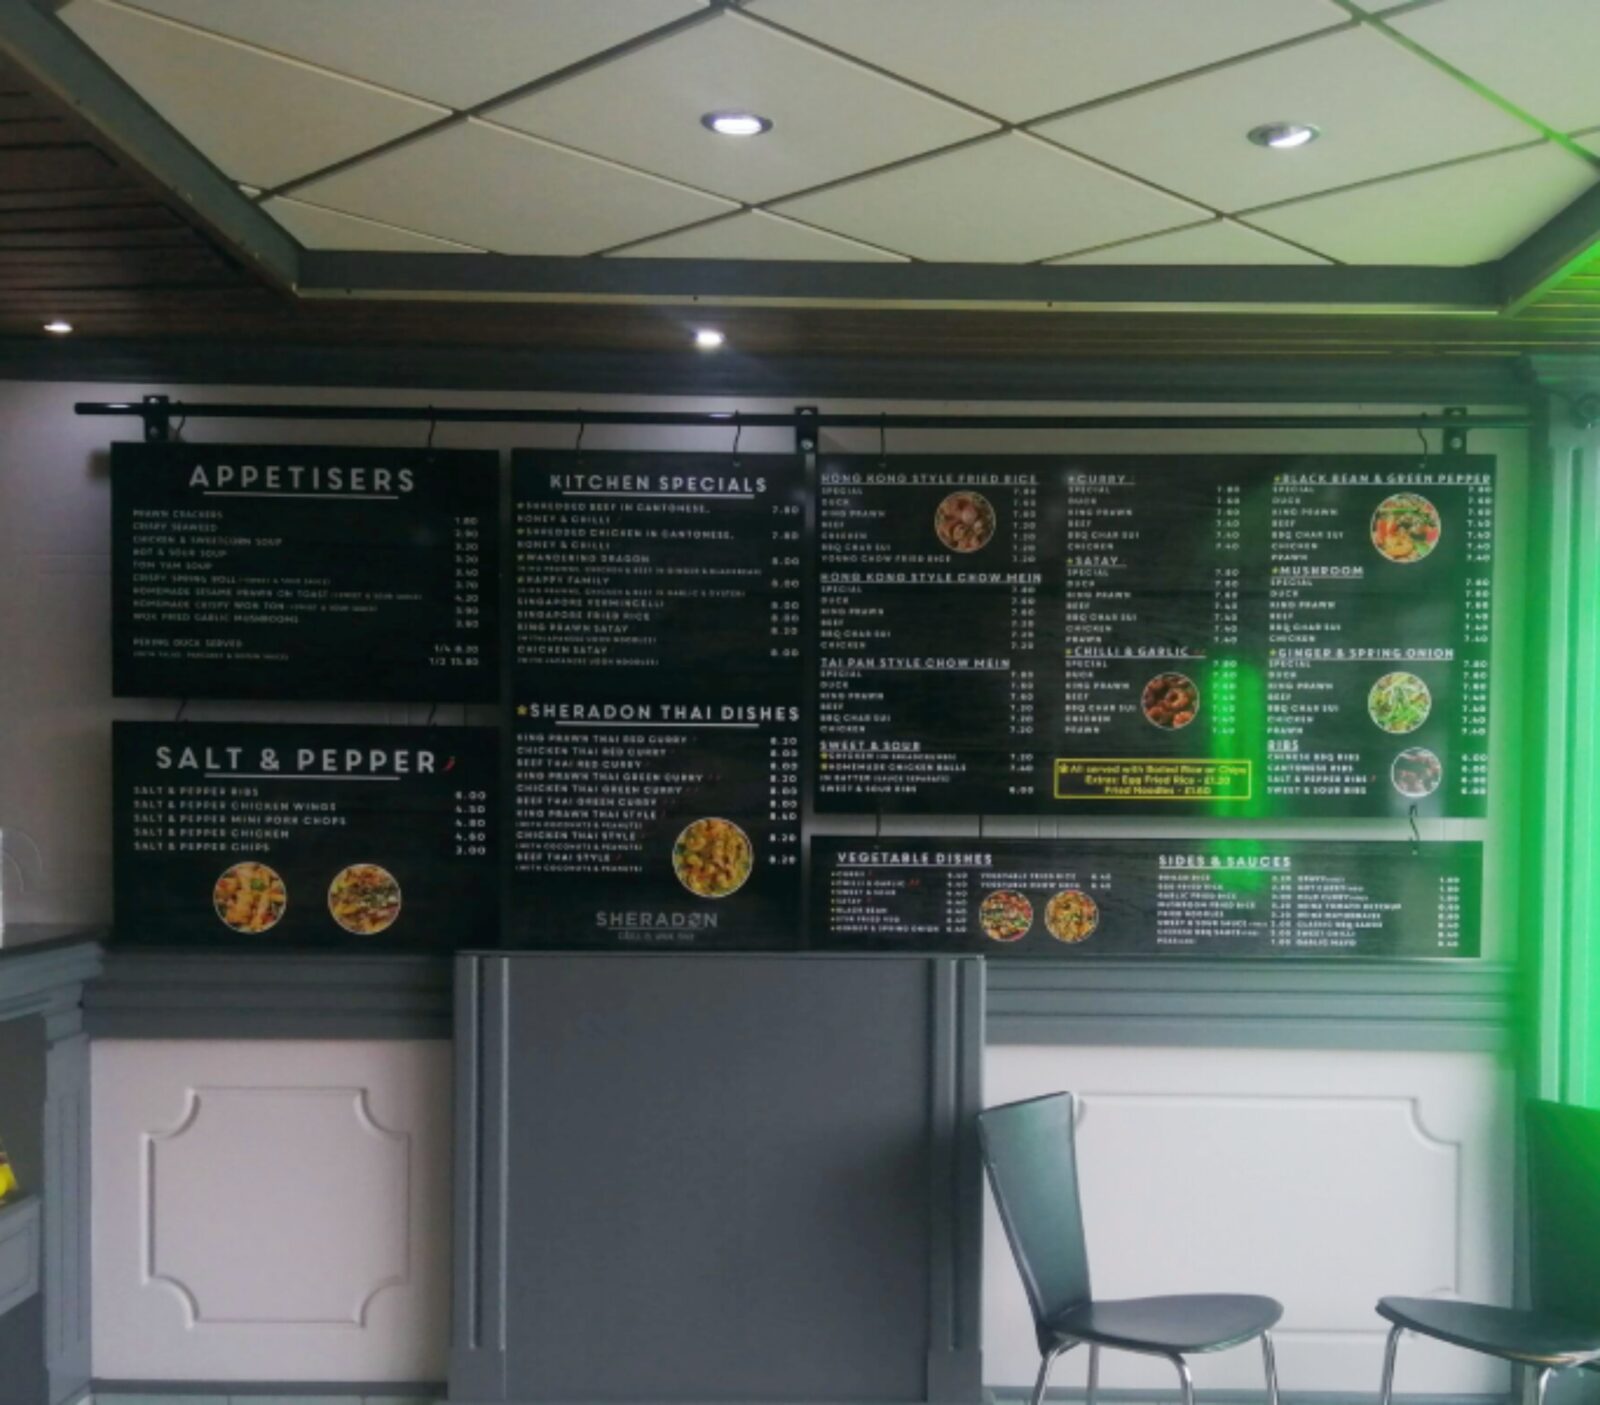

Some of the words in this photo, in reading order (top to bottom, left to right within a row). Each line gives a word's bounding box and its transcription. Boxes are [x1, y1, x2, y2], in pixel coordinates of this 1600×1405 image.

[189, 466, 414, 492] APPETISERS
[821, 474, 862, 483] HONG
[867, 474, 907, 483] KONG
[912, 474, 952, 483] STYLE
[958, 474, 999, 483] FRIED
[1004, 474, 1036, 483] RICE
[1077, 475, 1125, 483] CURRY
[1283, 474, 1326, 483] BLACK
[1332, 475, 1368, 483] BEAN
[1374, 475, 1381, 483] &
[1387, 475, 1432, 483] GREEN
[1438, 475, 1490, 483] PEPPER
[550, 475, 649, 492] KITCHEN
[659, 476, 767, 493] SPECIALS
[526, 503, 586, 511] SHREDDED
[590, 503, 616, 512] BEEF
[620, 504, 632, 512] IN
[526, 529, 586, 538] SHREDDED
[590, 529, 642, 538] CHICKEN
[646, 530, 657, 539] IN
[1075, 557, 1118, 565] SATAY
[1280, 567, 1363, 575] MUSHROOM
[820, 574, 861, 582] HONG
[866, 574, 905, 582] KONG
[911, 574, 951, 582] STYLE
[957, 574, 1001, 582] CHOW
[1007, 574, 1041, 582] MEIN
[1075, 647, 1119, 656] CHILLI
[1124, 648, 1131, 656] &
[1138, 648, 1188, 657] GARLIC
[1279, 649, 1330, 657] GINGER
[1336, 649, 1344, 657] &
[1349, 649, 1401, 657] SPRING
[1406, 649, 1453, 658] ONION
[821, 658, 842, 667] TAI
[848, 658, 874, 667] PAN
[880, 658, 920, 668] STYLE
[925, 659, 969, 668] CHOW
[974, 659, 1010, 668] MEIN
[530, 704, 650, 720] SHERADON
[660, 706, 711, 721] THAI
[721, 707, 799, 722] DISHES
[593, 735, 619, 743] THAI
[516, 746, 568, 755] CHICKEN
[573, 747, 597, 755] THAI
[821, 741, 864, 750] SWEET
[871, 742, 878, 750] &
[883, 742, 920, 750] SOUR
[157, 747, 242, 771] SALT
[259, 748, 280, 771] &
[298, 749, 435, 774] PEPPER
[593, 773, 619, 782] THAI
[133, 787, 163, 796] SALT
[168, 787, 176, 796] &
[180, 787, 226, 797] PEPPER
[231, 788, 259, 797] RIBS
[516, 784, 568, 793] CHICKEN
[572, 785, 597, 793] THAI
[602, 785, 639, 794] GREEN
[133, 800, 163, 809] SALT
[168, 801, 176, 810] &
[180, 801, 226, 810] PEPPER
[231, 802, 289, 811] CHICKEN
[293, 802, 336, 811] WINGS
[133, 815, 163, 824] SALT
[168, 815, 176, 824] &
[180, 815, 226, 824] PEPPER
[231, 816, 261, 825] MINI
[265, 816, 298, 825] PORK
[303, 817, 346, 826] CHOPS
[133, 828, 163, 837] SALT
[168, 829, 176, 837] &
[180, 829, 226, 838] PEPPER
[231, 829, 289, 839] CHICKEN
[516, 831, 568, 840] CHICKEN
[573, 832, 598, 841] THAI
[603, 832, 636, 841] STYLE
[133, 843, 163, 851] SALT
[168, 843, 176, 852] &
[180, 843, 226, 852] PEPPER
[231, 844, 270, 853] CHIPS
[838, 853, 928, 864] VEGETABLE
[936, 854, 992, 864] DISHES
[1159, 855, 1204, 867] SIDES
[1210, 856, 1219, 867] &
[1226, 856, 1291, 868] SAUCES
[596, 912, 718, 927] SHERADON
